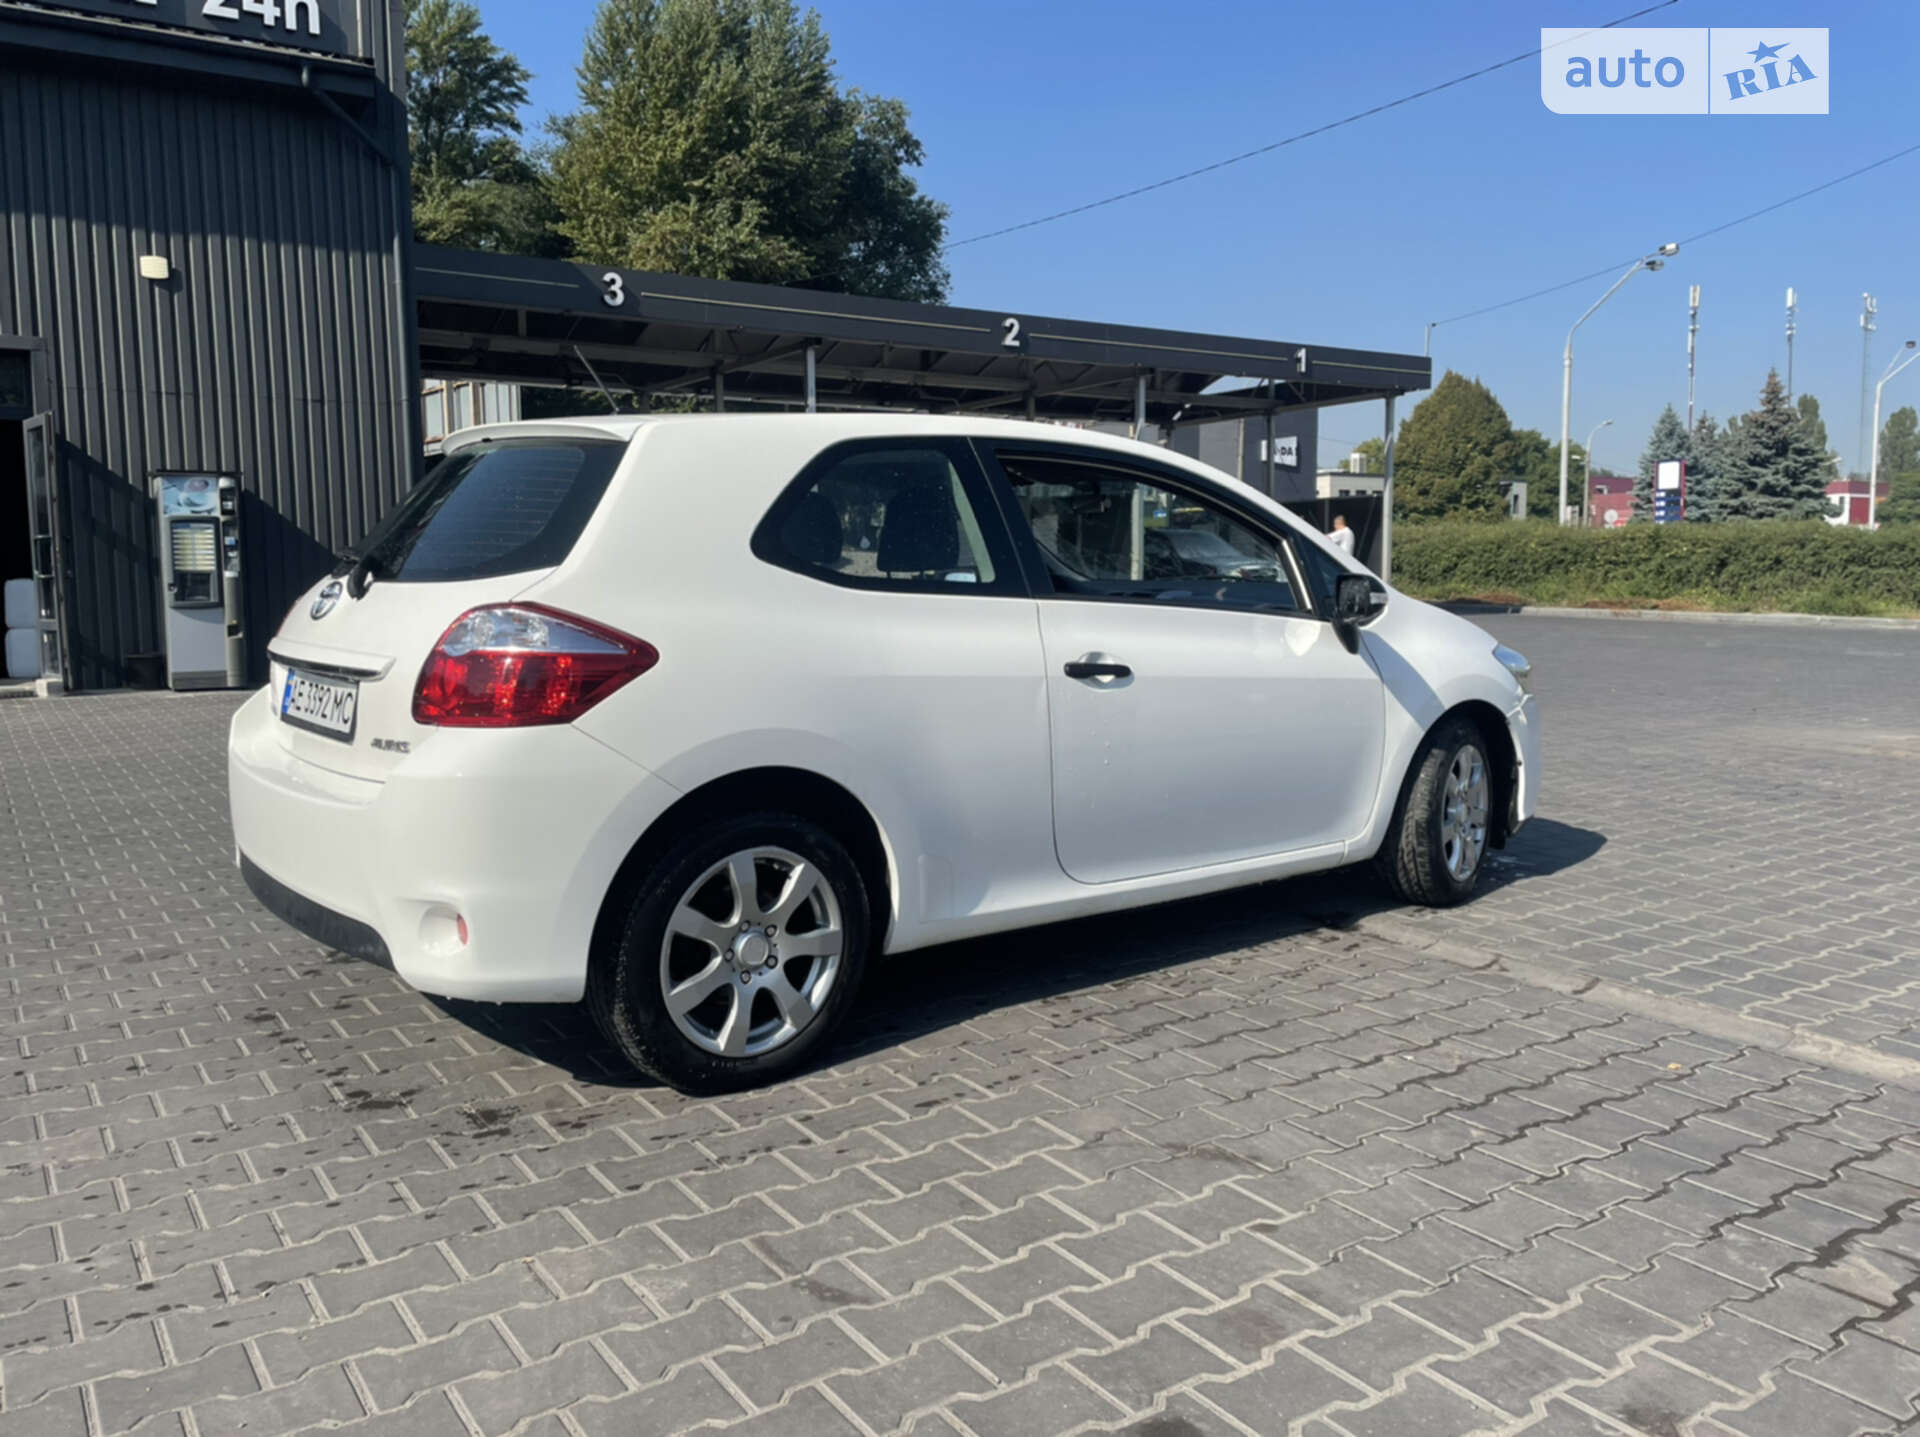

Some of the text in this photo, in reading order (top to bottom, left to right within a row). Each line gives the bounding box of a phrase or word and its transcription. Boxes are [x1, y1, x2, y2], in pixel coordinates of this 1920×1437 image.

[602, 272, 625, 306] 3
[1001, 318, 1020, 347] 2
[1295, 347, 1307, 374] 1
[303, 682, 331, 720] 3392
[329, 688, 354, 725] MC
